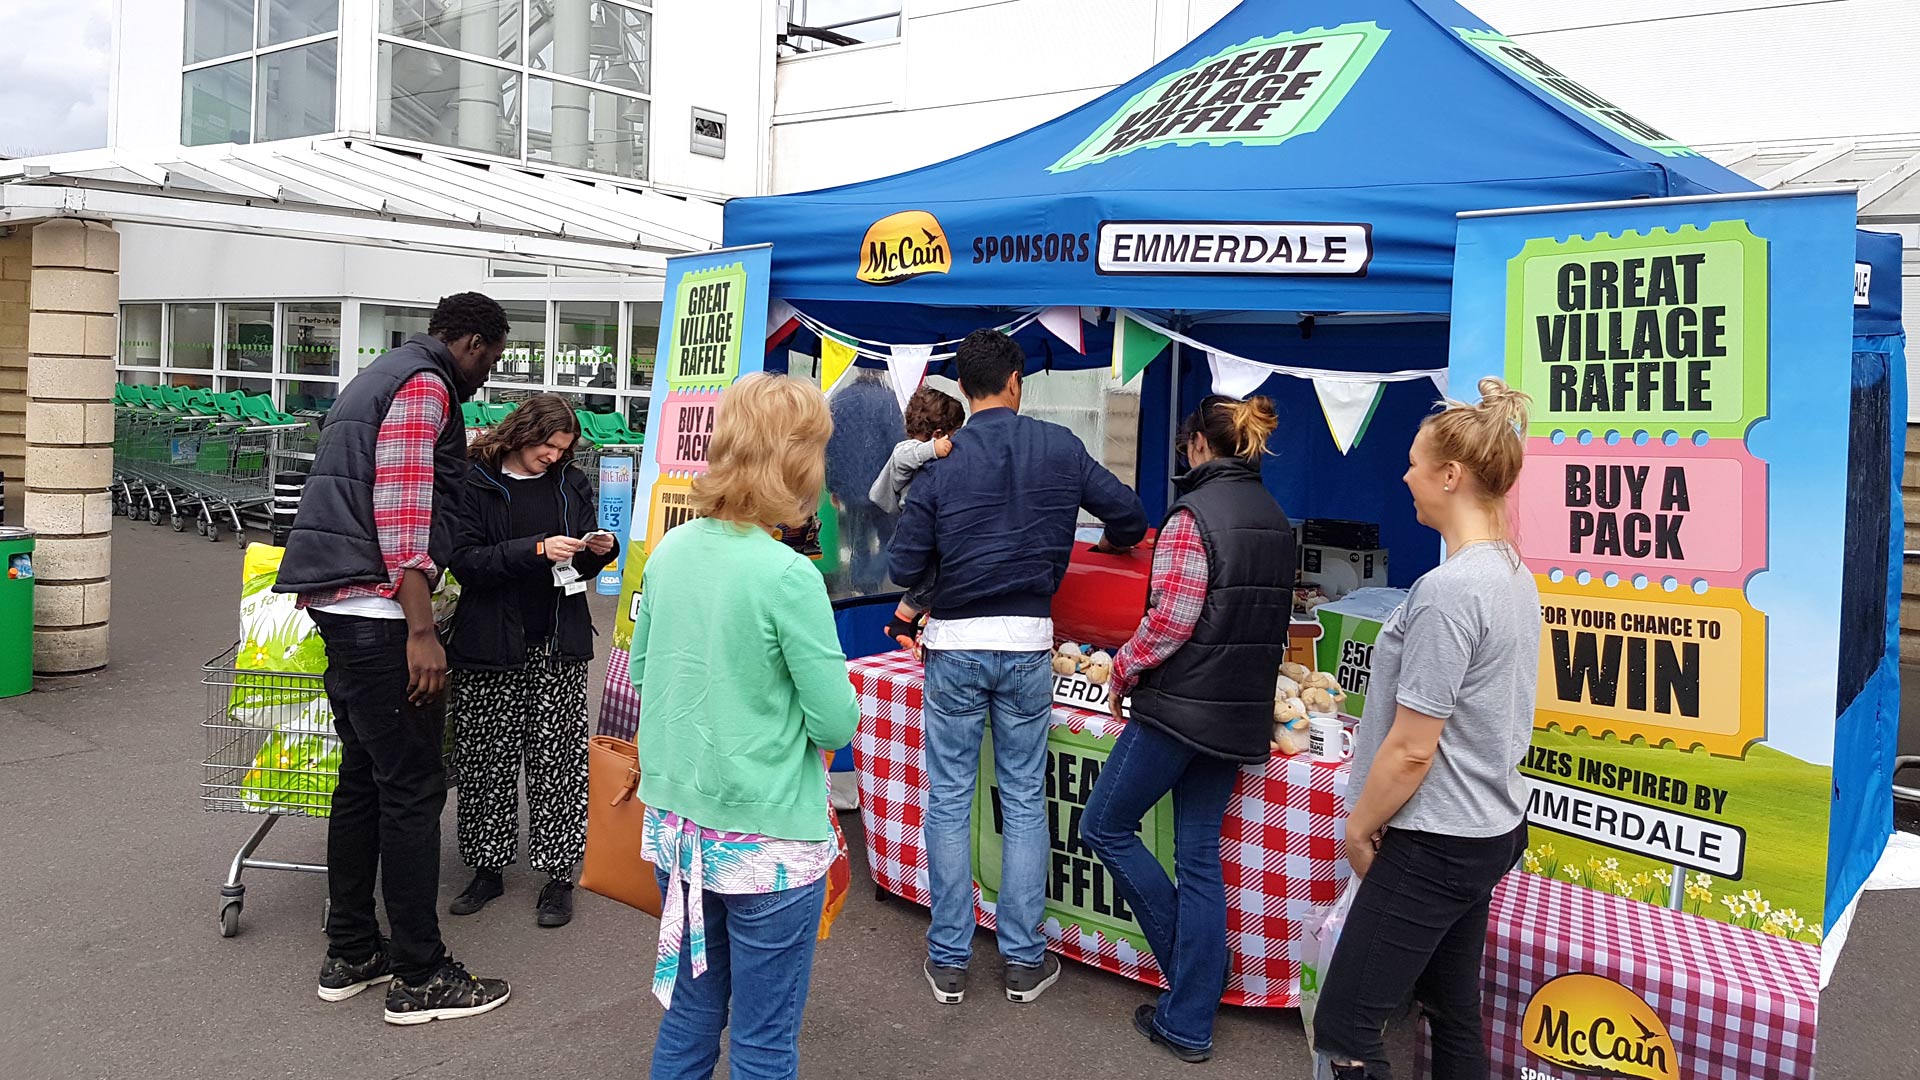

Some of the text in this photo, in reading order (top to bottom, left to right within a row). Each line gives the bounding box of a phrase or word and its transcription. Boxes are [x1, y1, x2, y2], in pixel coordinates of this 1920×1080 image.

[1157, 42, 1323, 103] GREAT
[1113, 71, 1322, 137] VILLAGE
[1093, 102, 1282, 157] RAFFLE
[864, 236, 945, 274] McCain
[972, 233, 1090, 264] SPONSORS
[1112, 233, 1348, 264] EMMERDALE
[688, 281, 731, 316] GREAT
[1557, 253, 1706, 312] GREAT
[680, 312, 734, 347] VILLAGE
[1536, 306, 1727, 363] VILLAGE
[679, 344, 727, 376] RAFFLE
[1550, 360, 1712, 412] RAFFLE
[678, 406, 714, 433] BUY A
[610, 504, 622, 513] for
[662, 492, 672, 504] FOR
[672, 492, 686, 505] YOUR
[1565, 464, 1690, 512] BUY A
[1569, 510, 1685, 561] PACK
[601, 575, 620, 584] ASDA
[1571, 608, 1616, 631] YOUR
[1620, 613, 1692, 638] CHANCE
[1697, 619, 1721, 640] TO
[1550, 628, 1700, 719] WIN
[1577, 757, 1688, 806] INSPIRED
[1693, 783, 1728, 815] BY
[1527, 788, 1722, 863] MMERDALE
[1533, 1004, 1669, 1075] McCain
